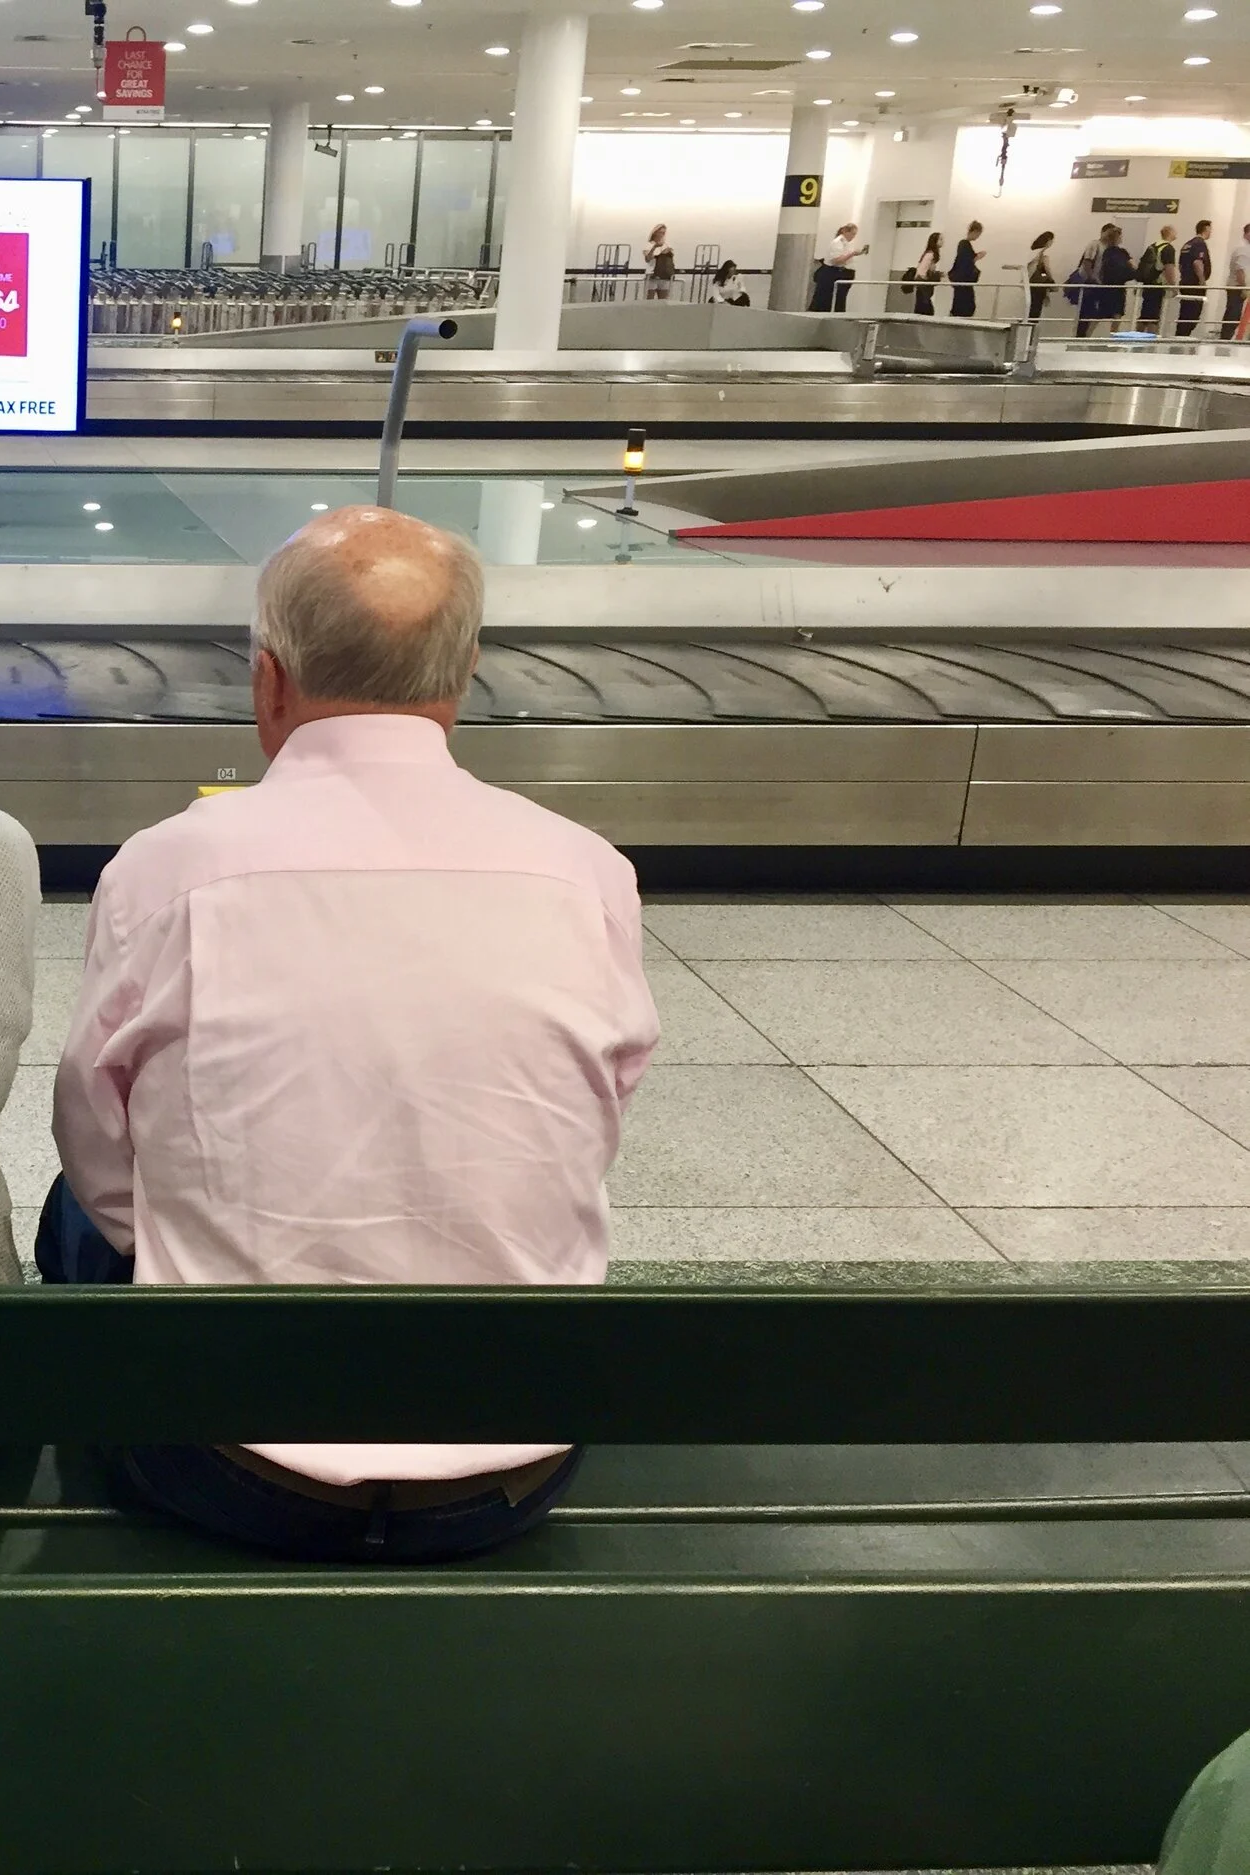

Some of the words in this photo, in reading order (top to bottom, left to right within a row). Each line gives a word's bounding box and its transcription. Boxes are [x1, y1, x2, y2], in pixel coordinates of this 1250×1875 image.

[125, 50, 146, 60] LAST
[117, 60, 152, 70] CHANCE
[126, 70, 143, 79] FOR
[120, 79, 149, 89] GREAT
[116, 89, 153, 98] SAVINGS
[799, 178, 818, 204] 9
[19, 400, 56, 415] FREE
[219, 768, 234, 779] 04
